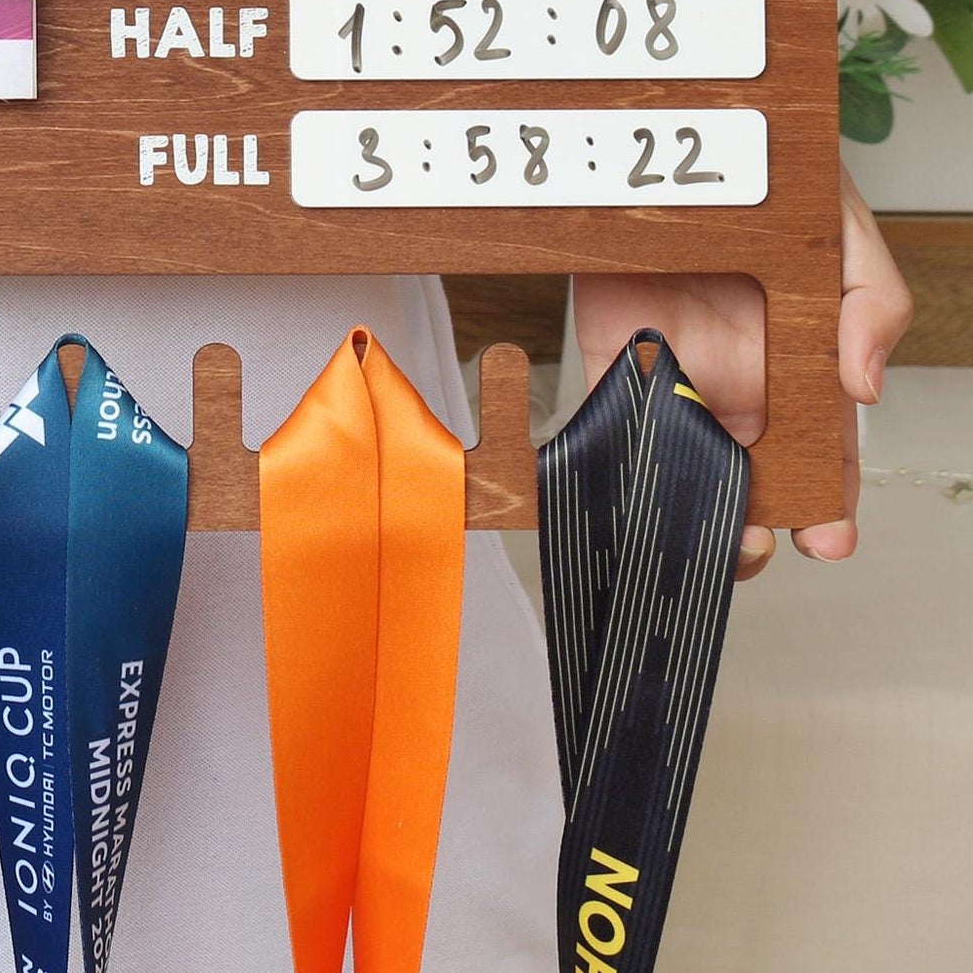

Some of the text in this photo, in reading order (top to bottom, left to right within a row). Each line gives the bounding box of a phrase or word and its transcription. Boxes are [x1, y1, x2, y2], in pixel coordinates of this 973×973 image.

[109, 7, 270, 59] HALF
[137, 134, 270, 186] FULL
[6, 753, 39, 916] IONIQ
[41, 772, 56, 858] HYUNDAI
[88, 737, 112, 907] MIDNIGHT
[104, 660, 144, 973] EXPRESS MARATHO
[42, 900, 53, 923] BY
